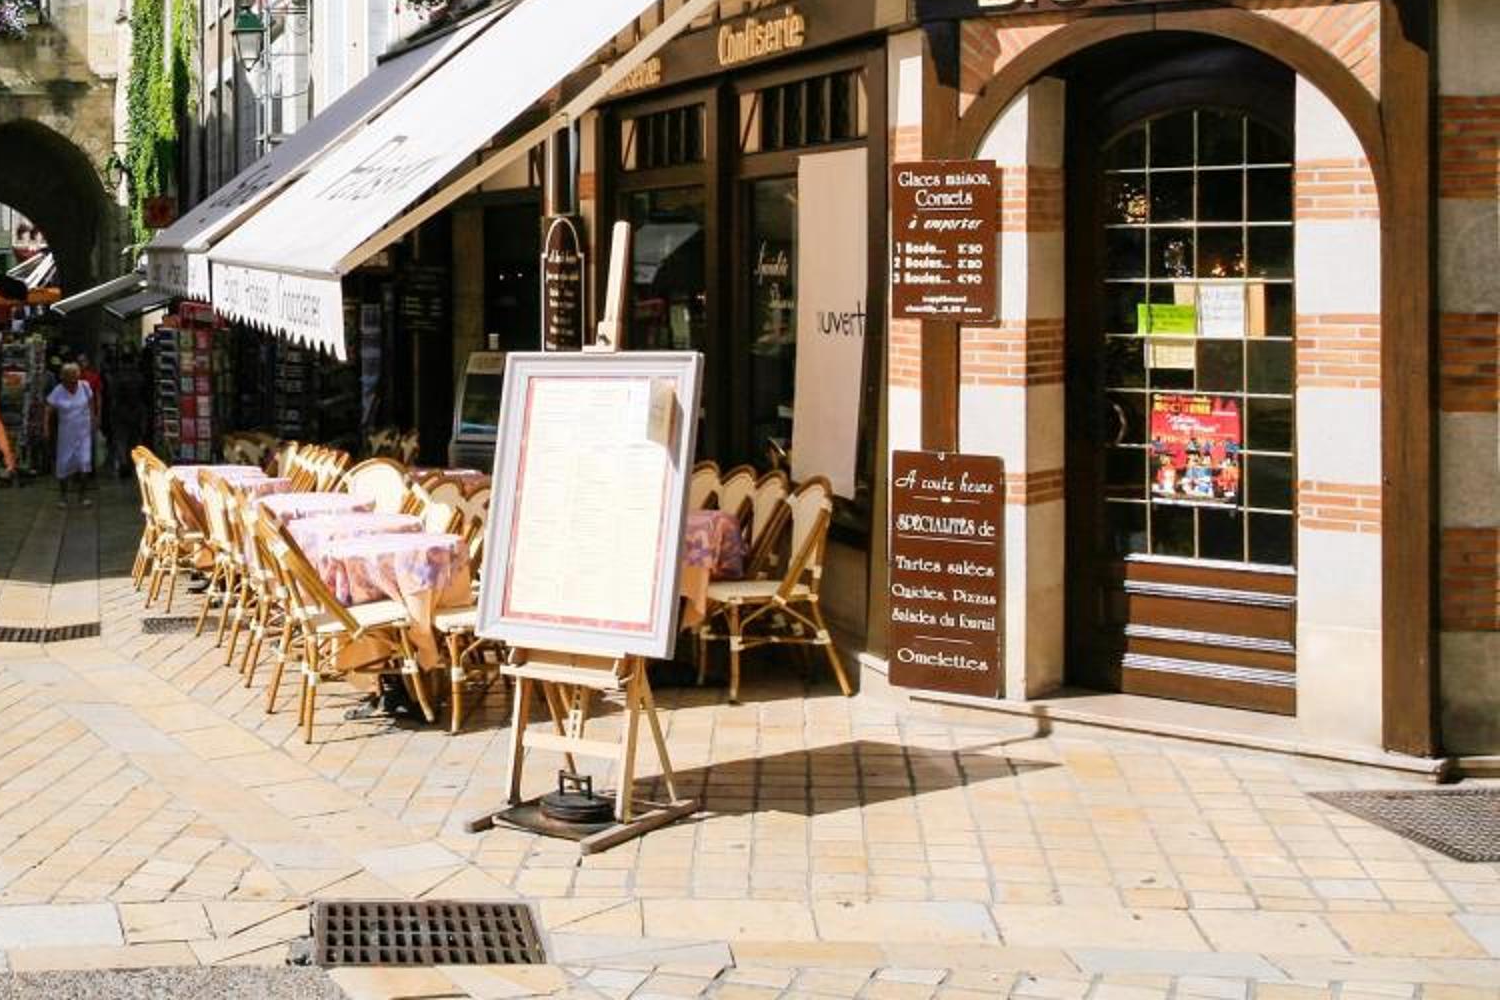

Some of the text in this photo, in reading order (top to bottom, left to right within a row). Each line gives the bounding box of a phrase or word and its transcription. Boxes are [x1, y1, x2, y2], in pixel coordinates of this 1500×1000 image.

[717, 6, 806, 66] Confiserie
[977, 520, 995, 537] de
[895, 555, 942, 573] Tartes
[897, 647, 989, 671] Omelettes
